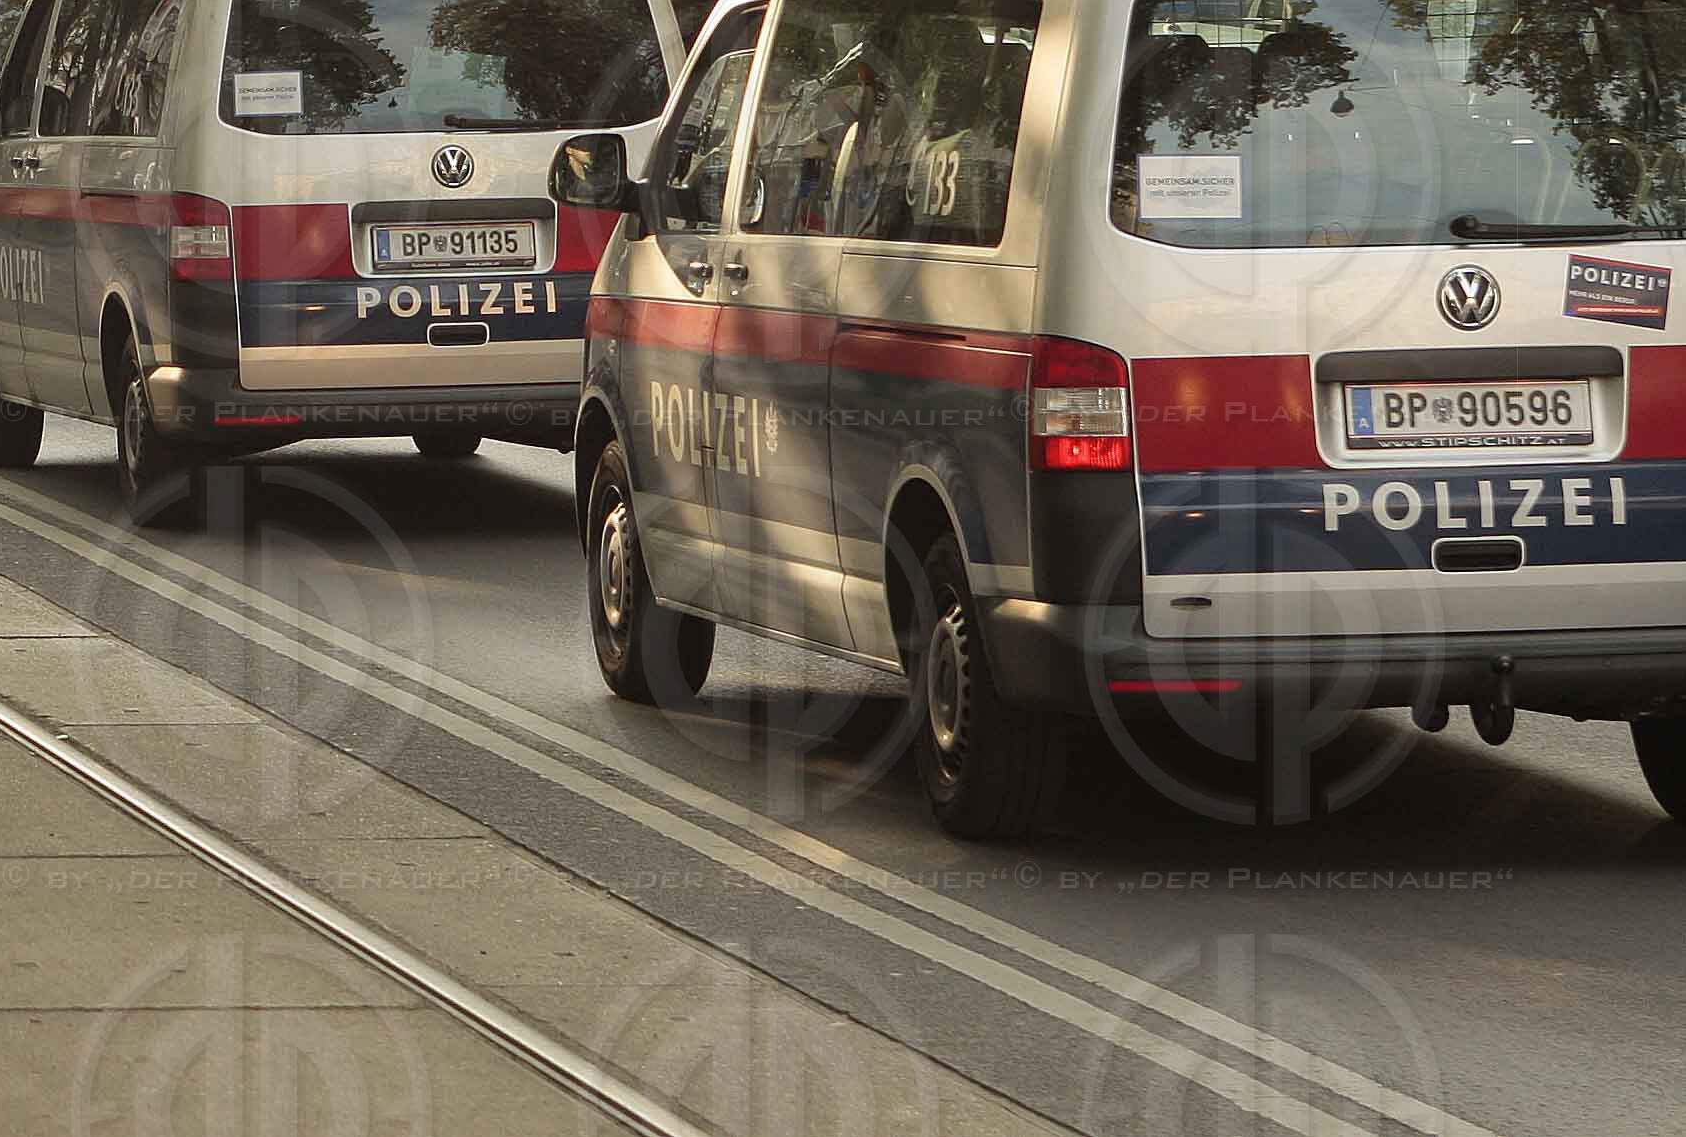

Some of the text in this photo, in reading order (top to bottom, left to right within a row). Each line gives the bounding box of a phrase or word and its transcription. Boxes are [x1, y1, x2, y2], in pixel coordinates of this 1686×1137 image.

[402, 230, 518, 257] BP 91135
[1570, 265, 1655, 291] POLIZEI
[357, 281, 557, 319] POLIZEI
[1383, 392, 1427, 428] BP
[1457, 389, 1573, 427] 90596
[650, 380, 761, 477] POLIZEI
[1322, 477, 1627, 532] POLIZEI
